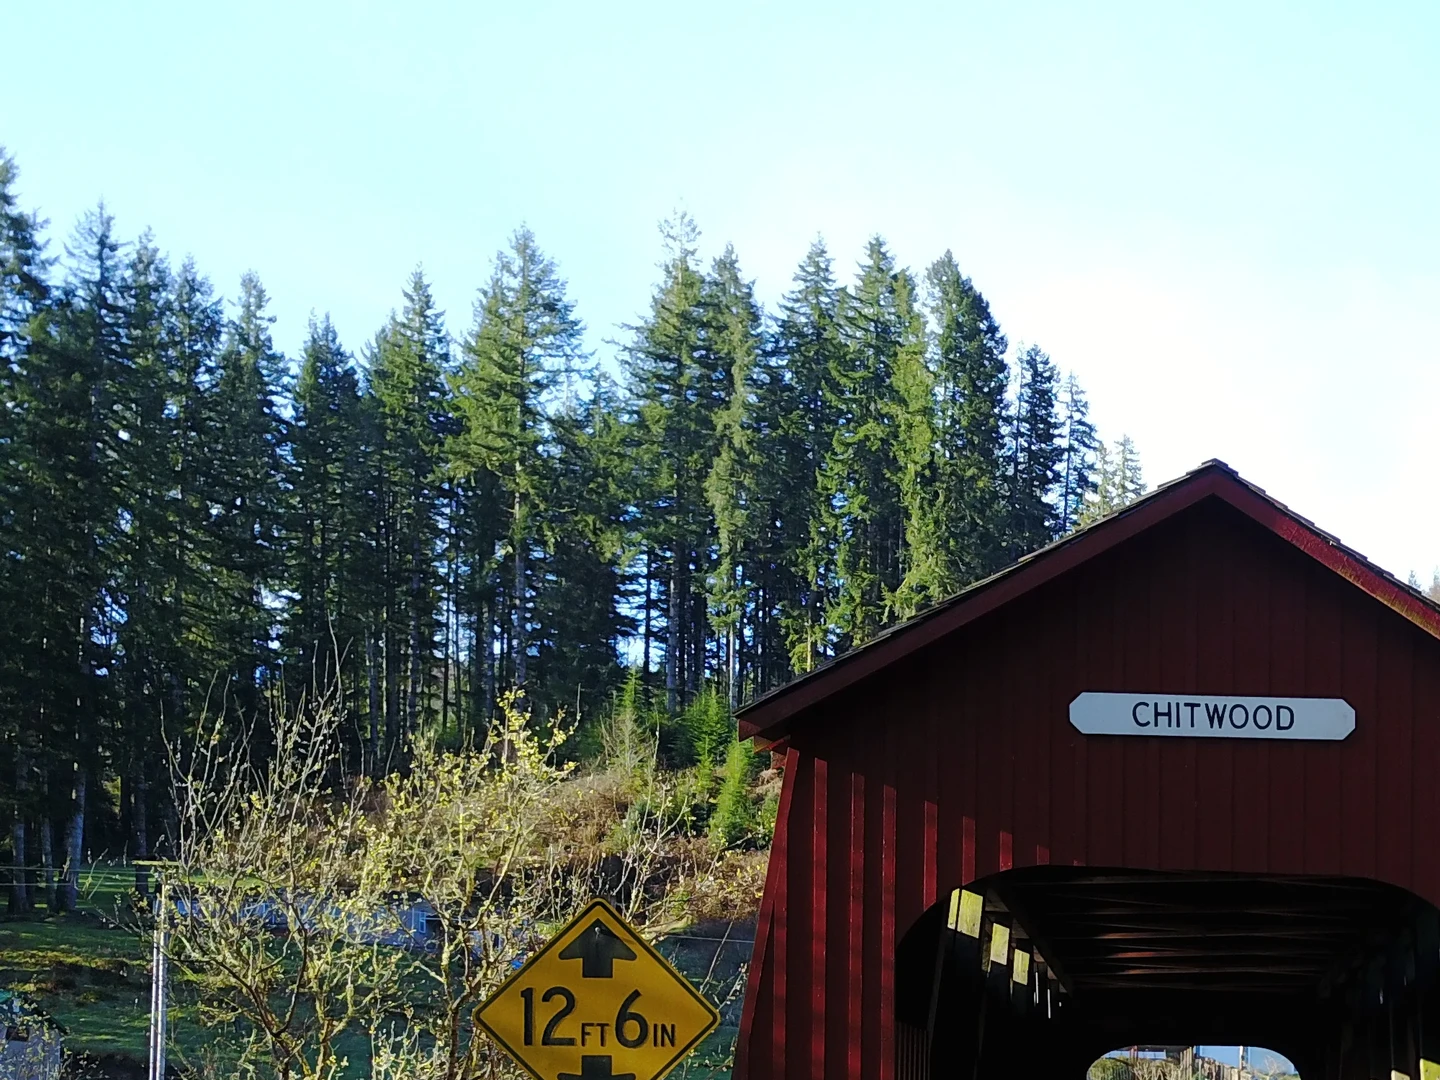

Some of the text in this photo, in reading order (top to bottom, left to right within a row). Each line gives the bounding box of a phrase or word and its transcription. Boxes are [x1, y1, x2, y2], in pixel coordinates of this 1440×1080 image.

[1131, 701, 1295, 731] CHITWOOD
[520, 986, 676, 1049] 12 FT 6 IN
